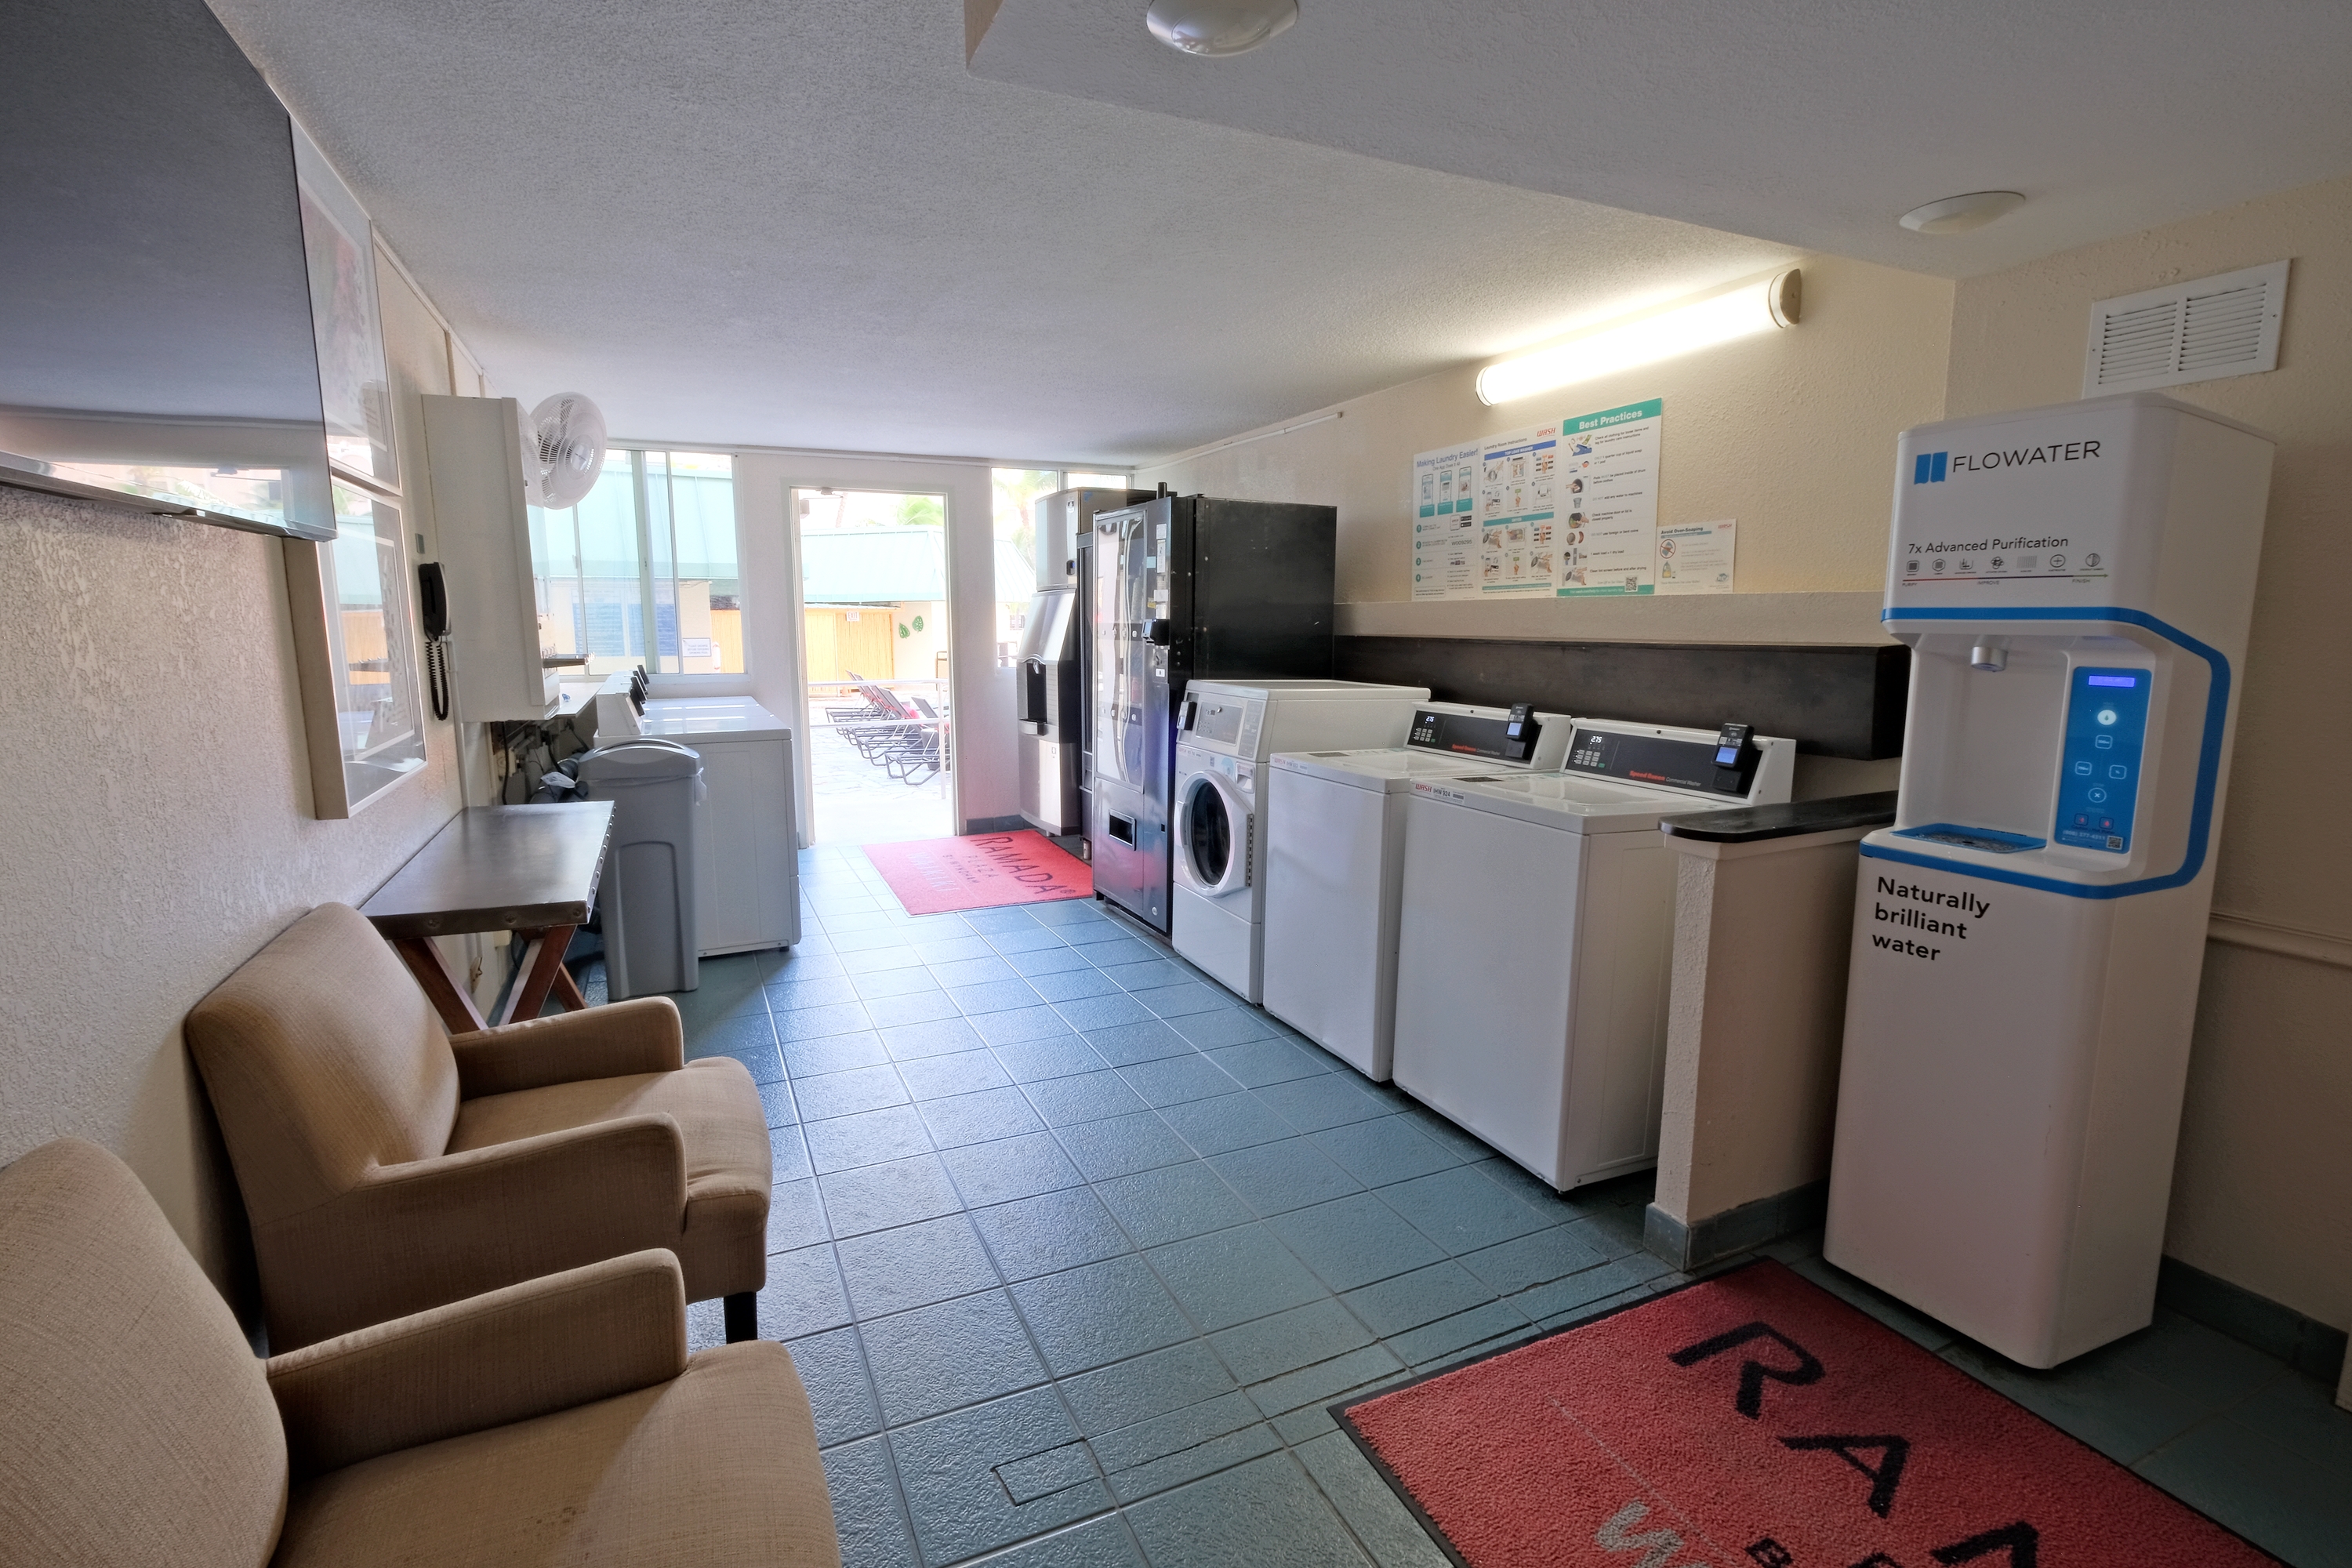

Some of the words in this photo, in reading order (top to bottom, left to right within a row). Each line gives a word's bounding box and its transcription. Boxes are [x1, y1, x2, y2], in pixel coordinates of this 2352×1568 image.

[1537, 427, 1556, 437] WASH
[1578, 419, 1599, 430] Best
[1600, 409, 1642, 426] Practices
[1417, 459, 1435, 468] Making
[1436, 454, 1458, 464] Laundry
[1459, 448, 1479, 459] Easier!
[1952, 440, 2101, 473] FLOWATER
[1907, 543, 1922, 554] 7x
[1925, 539, 1988, 554] Advanced
[1992, 535, 2069, 550] Purification
[1415, 783, 1432, 793] WASH
[907, 852, 960, 892] WAIKIKI
[1877, 876, 1991, 919] Naturally
[1875, 902, 1968, 939] brilliant
[1872, 931, 1940, 961] water
